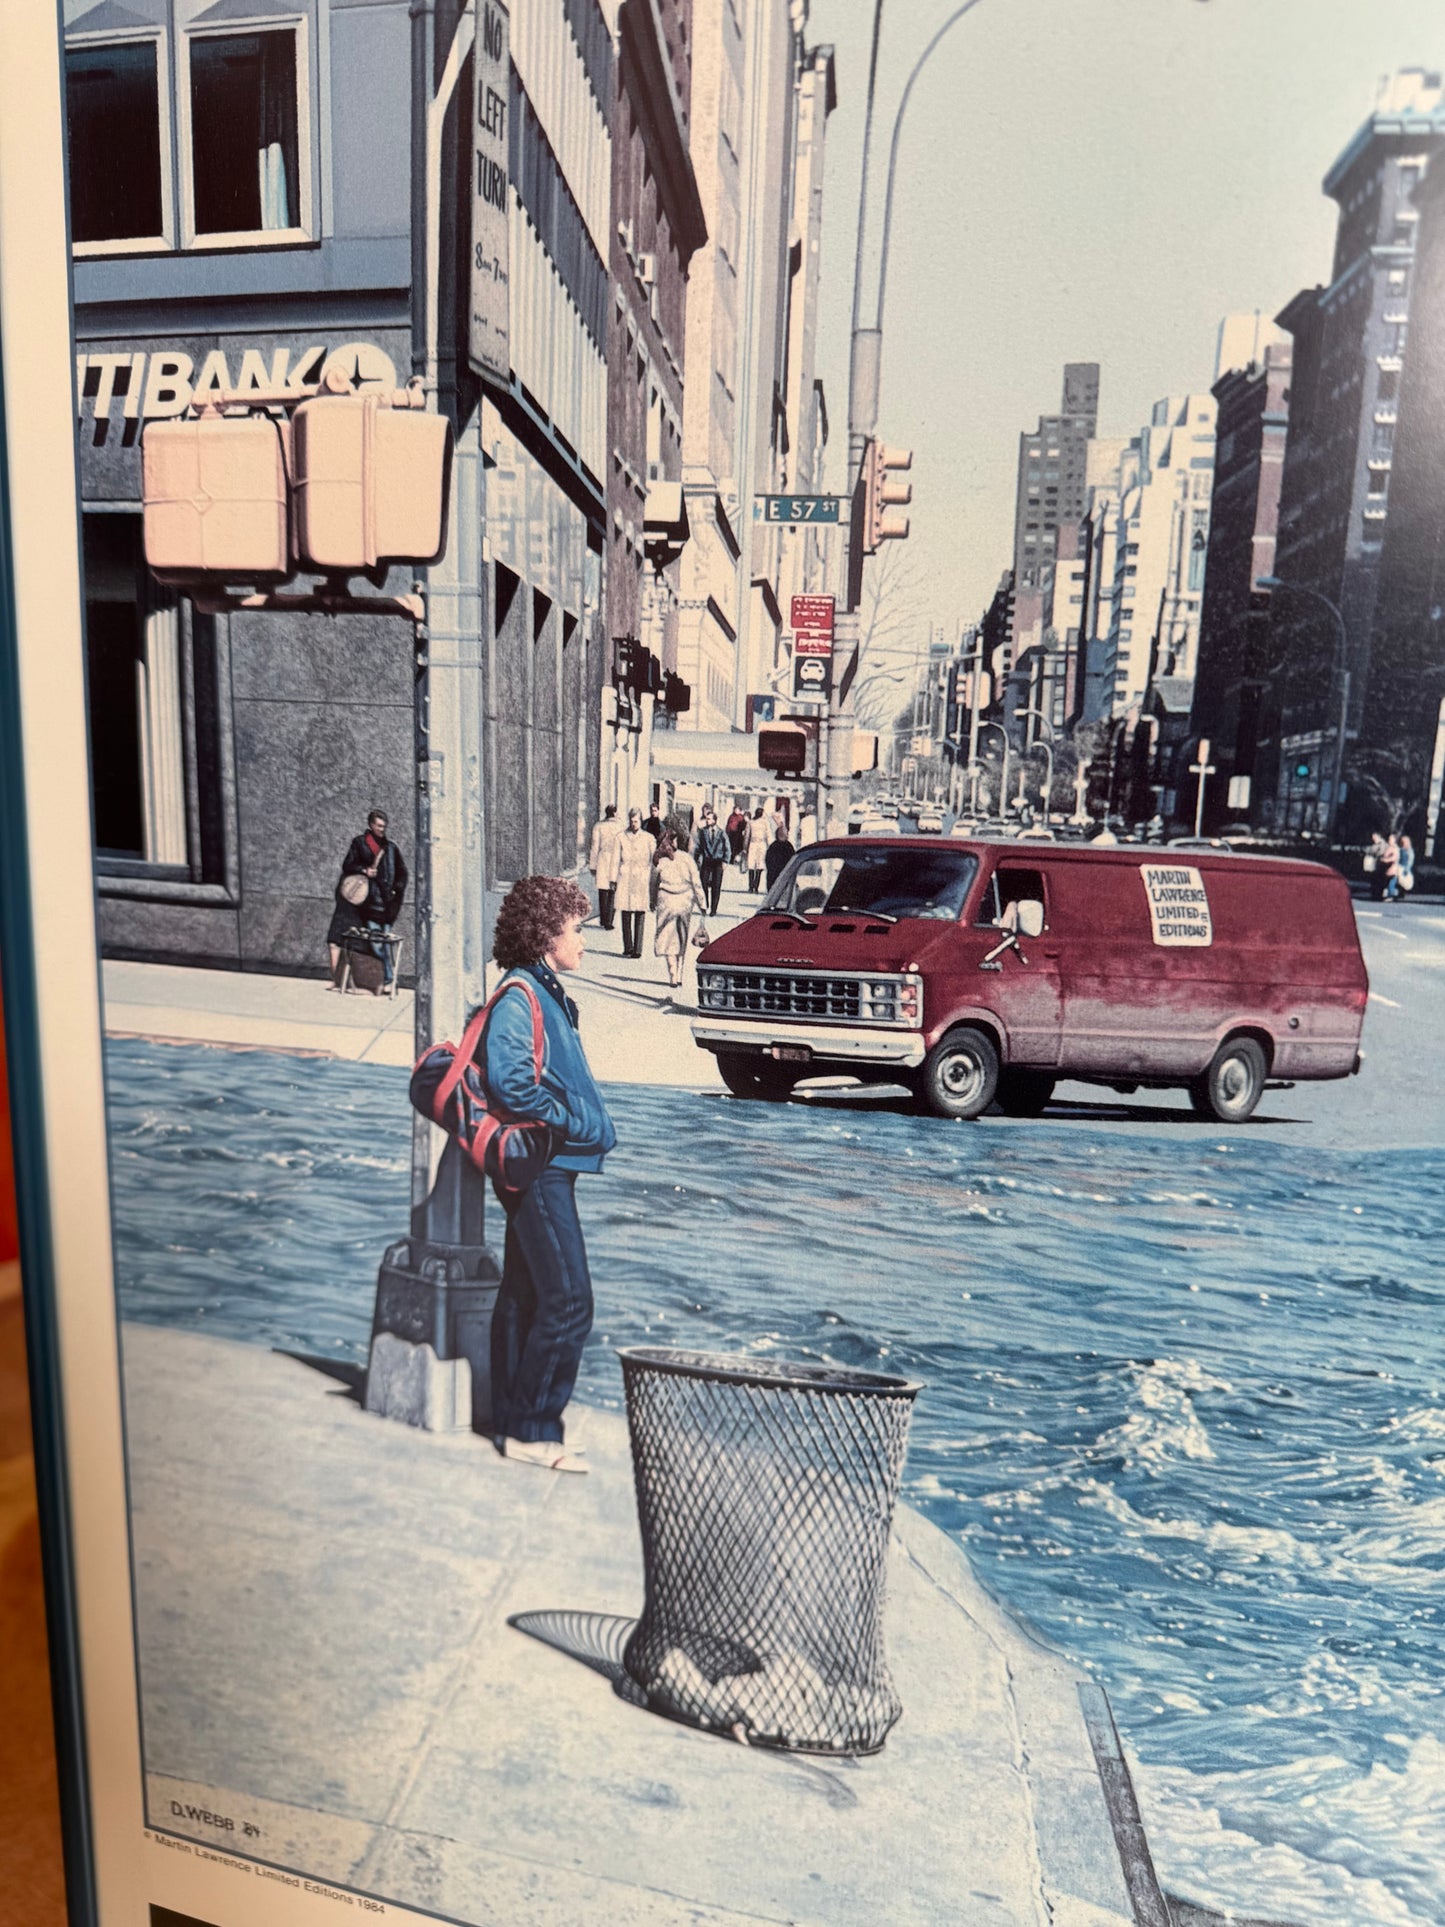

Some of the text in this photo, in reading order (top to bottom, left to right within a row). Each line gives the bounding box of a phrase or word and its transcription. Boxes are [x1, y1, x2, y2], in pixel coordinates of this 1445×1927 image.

[484, 1, 502, 62] NO
[478, 79, 507, 141] LEFT
[476, 149, 507, 215] TURN
[769, 501, 836, 519] E 57 ST
[1147, 870, 1191, 887] MARTIN
[1152, 888, 1206, 902] LAWRENCE
[1156, 906, 1199, 919] LIMITED
[1159, 923, 1207, 937] EDITIONS
[155, 1835, 192, 1853] Martin
[195, 1847, 251, 1872] Lawrence
[254, 1866, 300, 1888] Limited
[304, 1881, 353, 1905] Editions
[357, 1898, 385, 1914] 1984
